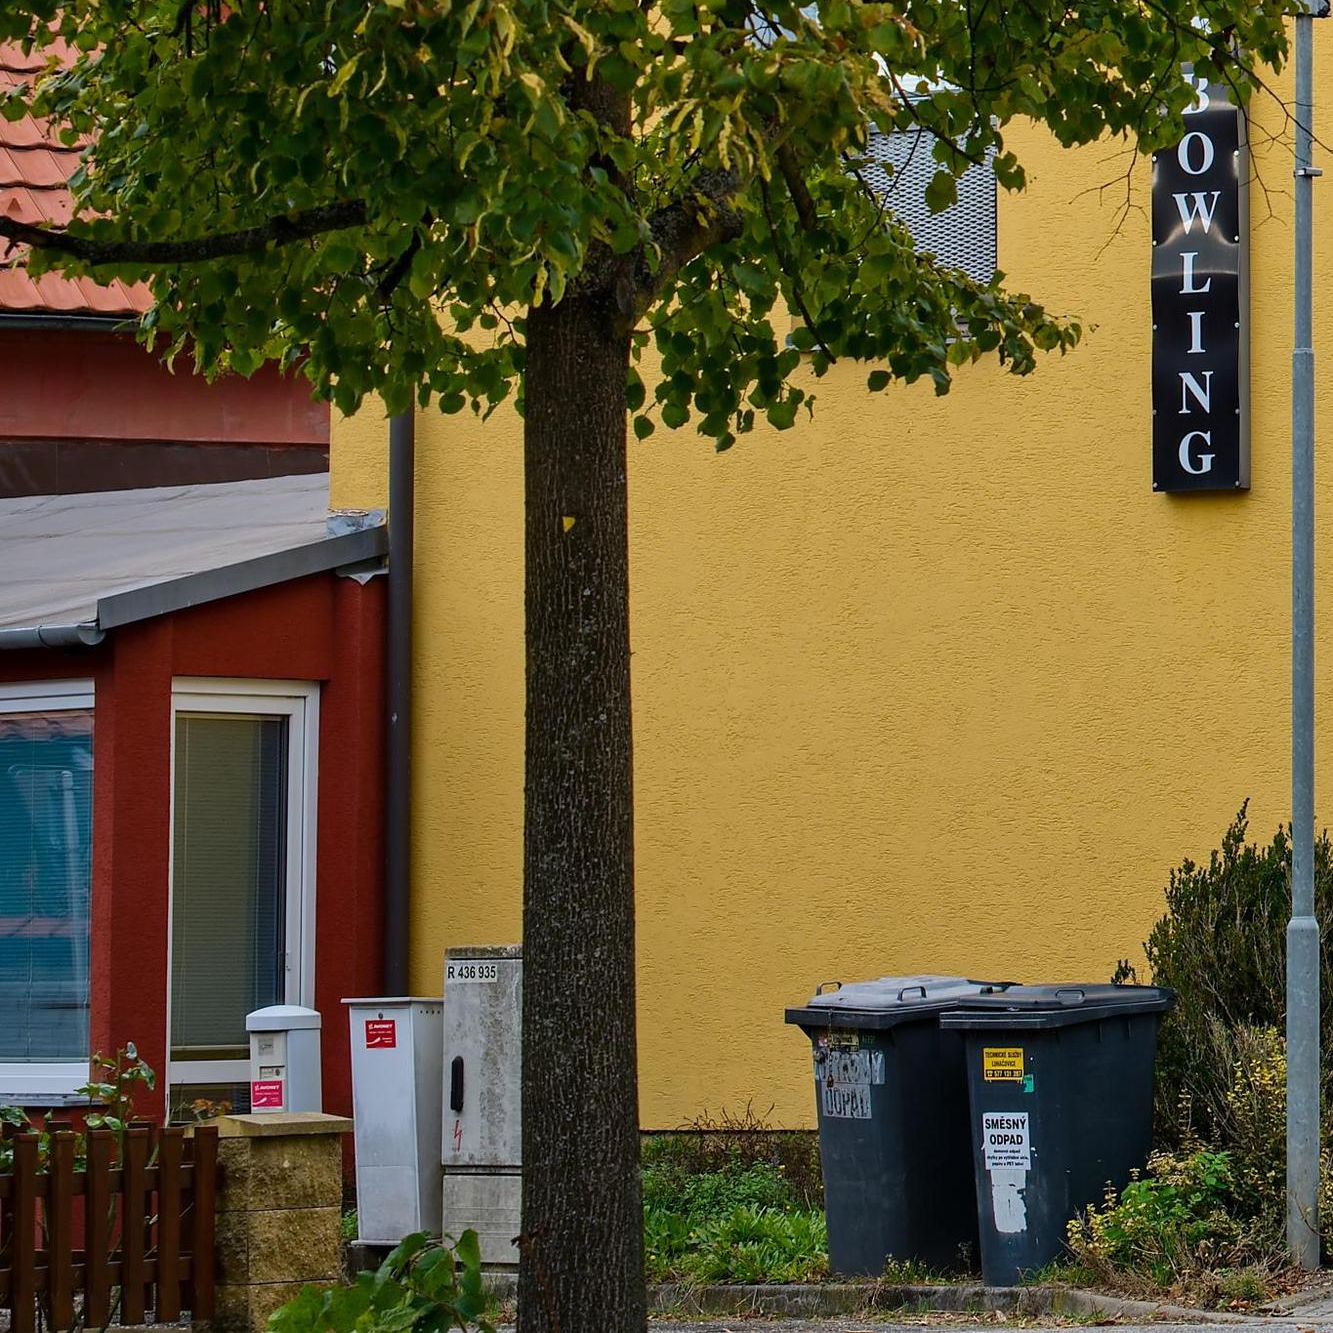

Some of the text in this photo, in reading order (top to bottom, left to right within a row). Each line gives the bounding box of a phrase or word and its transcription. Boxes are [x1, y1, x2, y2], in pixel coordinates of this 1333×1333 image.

[447, 965, 497, 979] R 436 935
[985, 1116, 1027, 1130] SMĚSNÝ
[990, 1134, 1024, 1145] ODPAD
